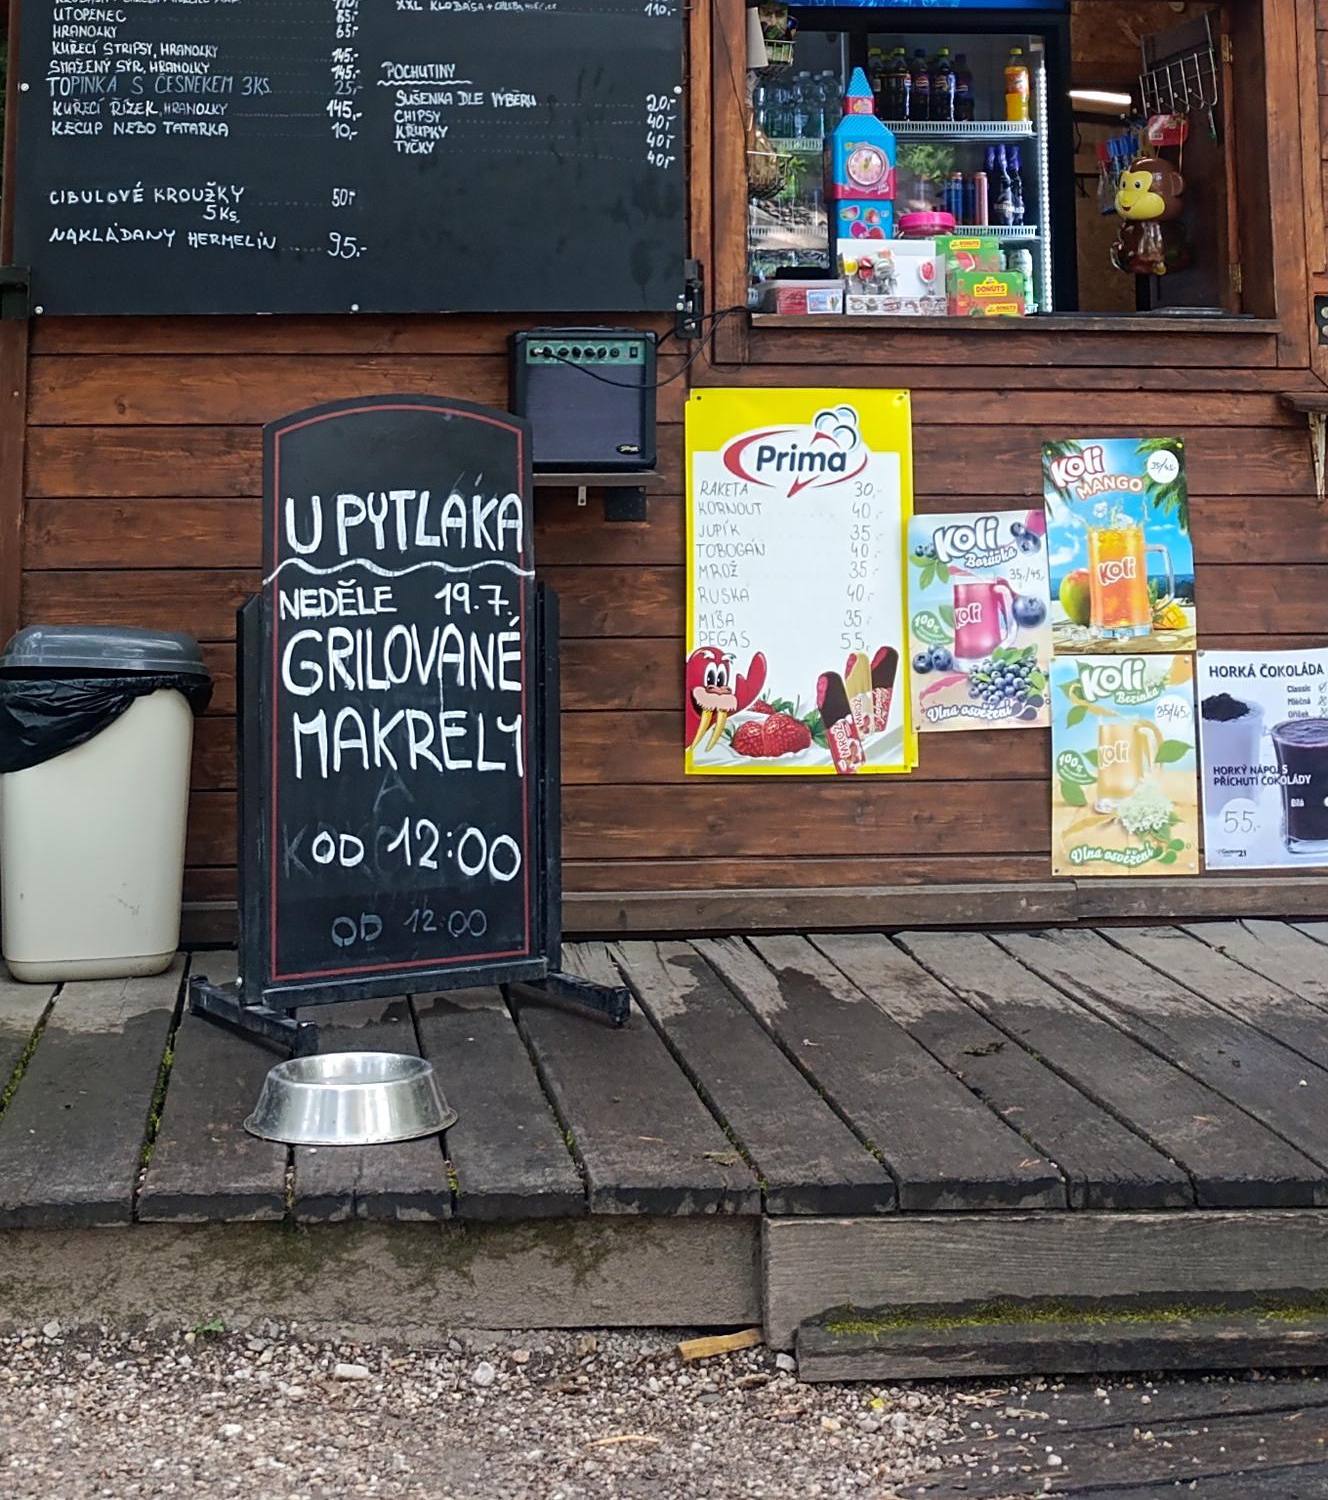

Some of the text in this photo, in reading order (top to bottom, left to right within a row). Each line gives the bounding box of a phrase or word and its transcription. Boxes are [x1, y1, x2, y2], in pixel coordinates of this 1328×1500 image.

[53, 6, 127, 22] UTOPENEC
[53, 24, 118, 39] HRANOLKY
[52, 38, 97, 56] KUŘECÍ
[160, 43, 219, 58] HRANOLKY
[49, 57, 111, 75] SMAŽENÝ
[149, 60, 211, 74] HRANOLKY
[381, 61, 456, 79] POCHUTINY
[46, 75, 118, 96] TOPINKA
[131, 77, 144, 95] S
[155, 71, 233, 93] ČESNEKEM
[53, 97, 105, 116] KUŘECÍ
[164, 102, 229, 116] HRANOLKY
[395, 89, 453, 106] SUŠENKA
[457, 92, 483, 106] DLE
[394, 109, 441, 123] CHIPSY
[51, 118, 103, 135] KEČUP
[113, 121, 156, 135] NEBO
[163, 121, 230, 138] TATARKA
[393, 140, 435, 154] TYČKY
[49, 181, 245, 204] CIBULOVÉ KROUŽKY
[202, 205, 217, 221] 5
[975, 284, 1007, 294] DONUTS
[756, 443, 847, 474] Prima
[1050, 445, 1104, 488] Koli
[700, 480, 748, 497] RAKETA
[1076, 475, 1143, 501] MANGO
[284, 469, 523, 557] U PYTLÁKA
[698, 501, 762, 516] KORNOUT
[699, 520, 740, 538] JUPÍK
[696, 539, 765, 558] TOBOGÁN
[933, 516, 999, 563] Koli
[698, 560, 739, 579] MROŽ
[1097, 557, 1136, 587] Koli
[279, 578, 398, 622] NEDĚLE
[699, 631, 751, 648] PEGAS
[281, 617, 523, 697] GRILOVANÉ
[1209, 662, 1324, 678] HORKÁ ČOKOLÁDA
[1080, 658, 1146, 703] Koli
[292, 709, 524, 780] MAKRELY
[1213, 765, 1247, 775] HORKÝ
[1282, 765, 1288, 773] S
[1262, 774, 1311, 786] ČOKOLÁDY
[312, 817, 522, 882] OD 12:00
[1070, 847, 1103, 865] Vlna
